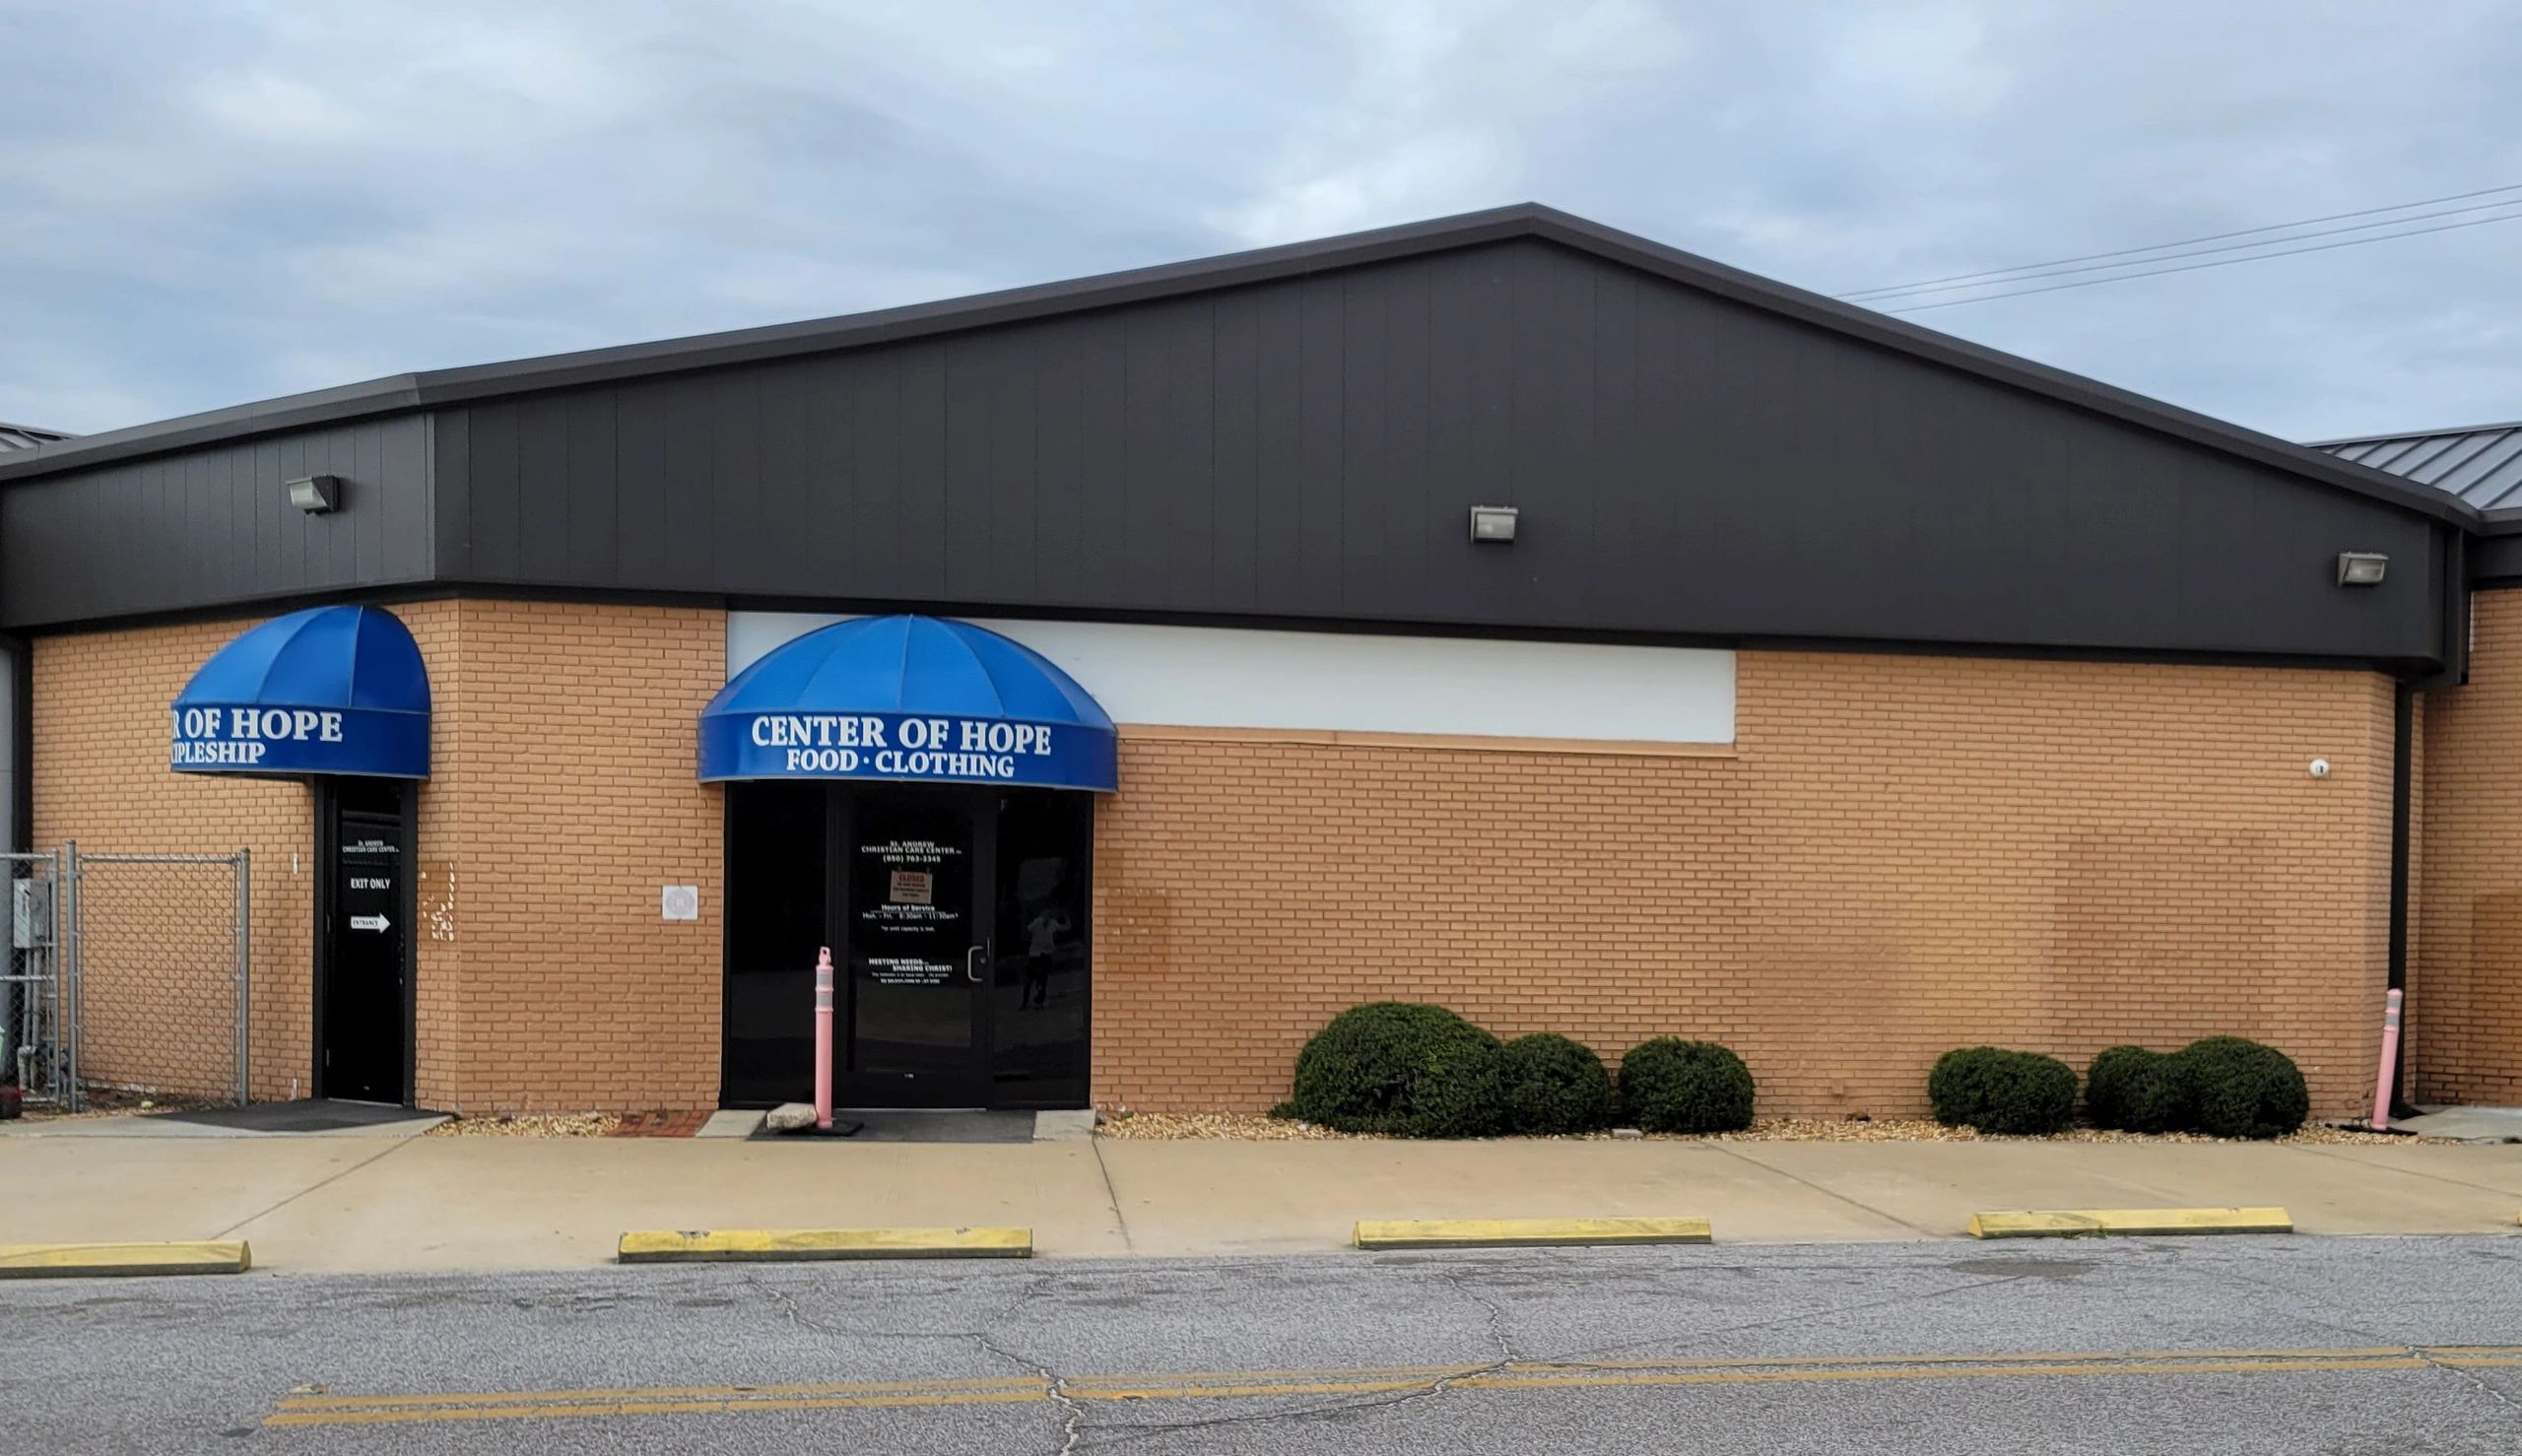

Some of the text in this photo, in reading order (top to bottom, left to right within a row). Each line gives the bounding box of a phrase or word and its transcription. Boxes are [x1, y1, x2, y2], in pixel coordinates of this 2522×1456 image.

[185, 708, 221, 739] OF
[231, 708, 343, 743] HOPE
[752, 715, 1051, 756] CENTER OF HOPE
[171, 741, 266, 764] IPLESHIP
[786, 749, 1015, 777] FOOD CLOTHING
[351, 878, 390, 890] EXIT ONLY
